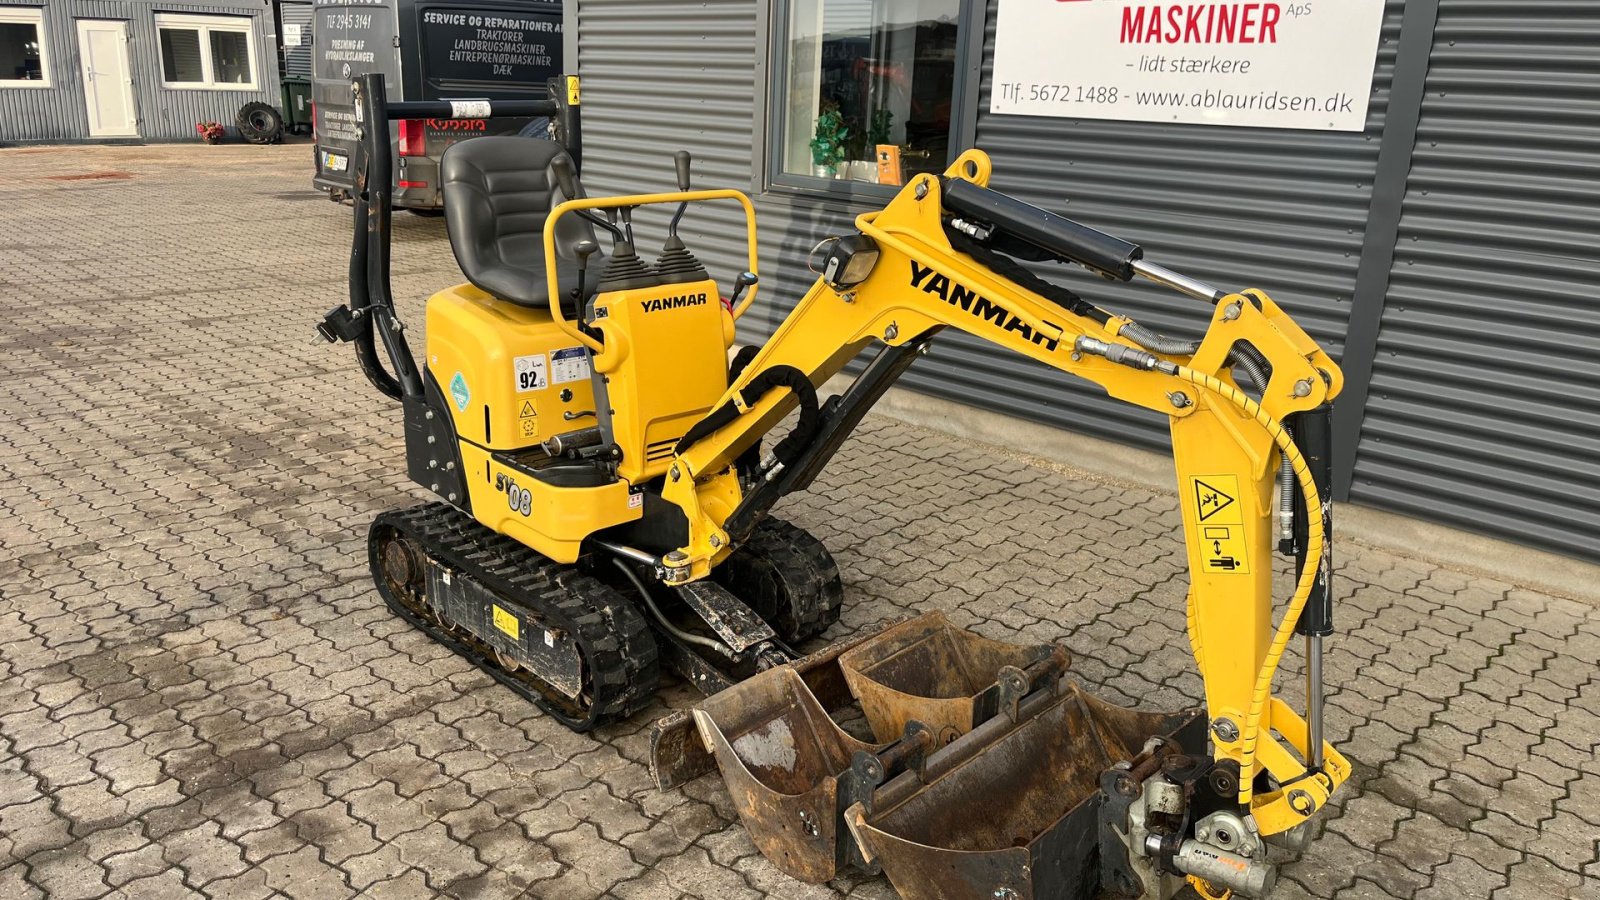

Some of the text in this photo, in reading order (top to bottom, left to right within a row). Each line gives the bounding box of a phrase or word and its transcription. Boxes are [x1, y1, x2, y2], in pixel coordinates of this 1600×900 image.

[336, 14, 353, 29] 2945
[354, 14, 372, 29] 3141
[424, 12, 466, 25] SERVICE
[469, 15, 482, 27] OG
[485, 17, 553, 32] REPARATIONER
[1120, 2, 1312, 43] MASKINER ApS
[476, 28, 524, 42] TRAKTORER
[454, 39, 546, 55] LANDBRUGSMASKINER
[449, 50, 552, 67] ENTREPRENØRMASKINER
[1138, 55, 1166, 72] lidt
[1169, 56, 1250, 73] stærkere
[493, 64, 513, 75] DÆK
[1001, 83, 1024, 104] Tlf.
[1029, 84, 1070, 102] 5672
[1075, 86, 1119, 103] 1488
[1136, 89, 1353, 112] www.ablauridsen.dk
[641, 293, 707, 313] YANMAR
[911, 259, 1063, 351] YANMAR
[520, 371, 537, 389] 92
